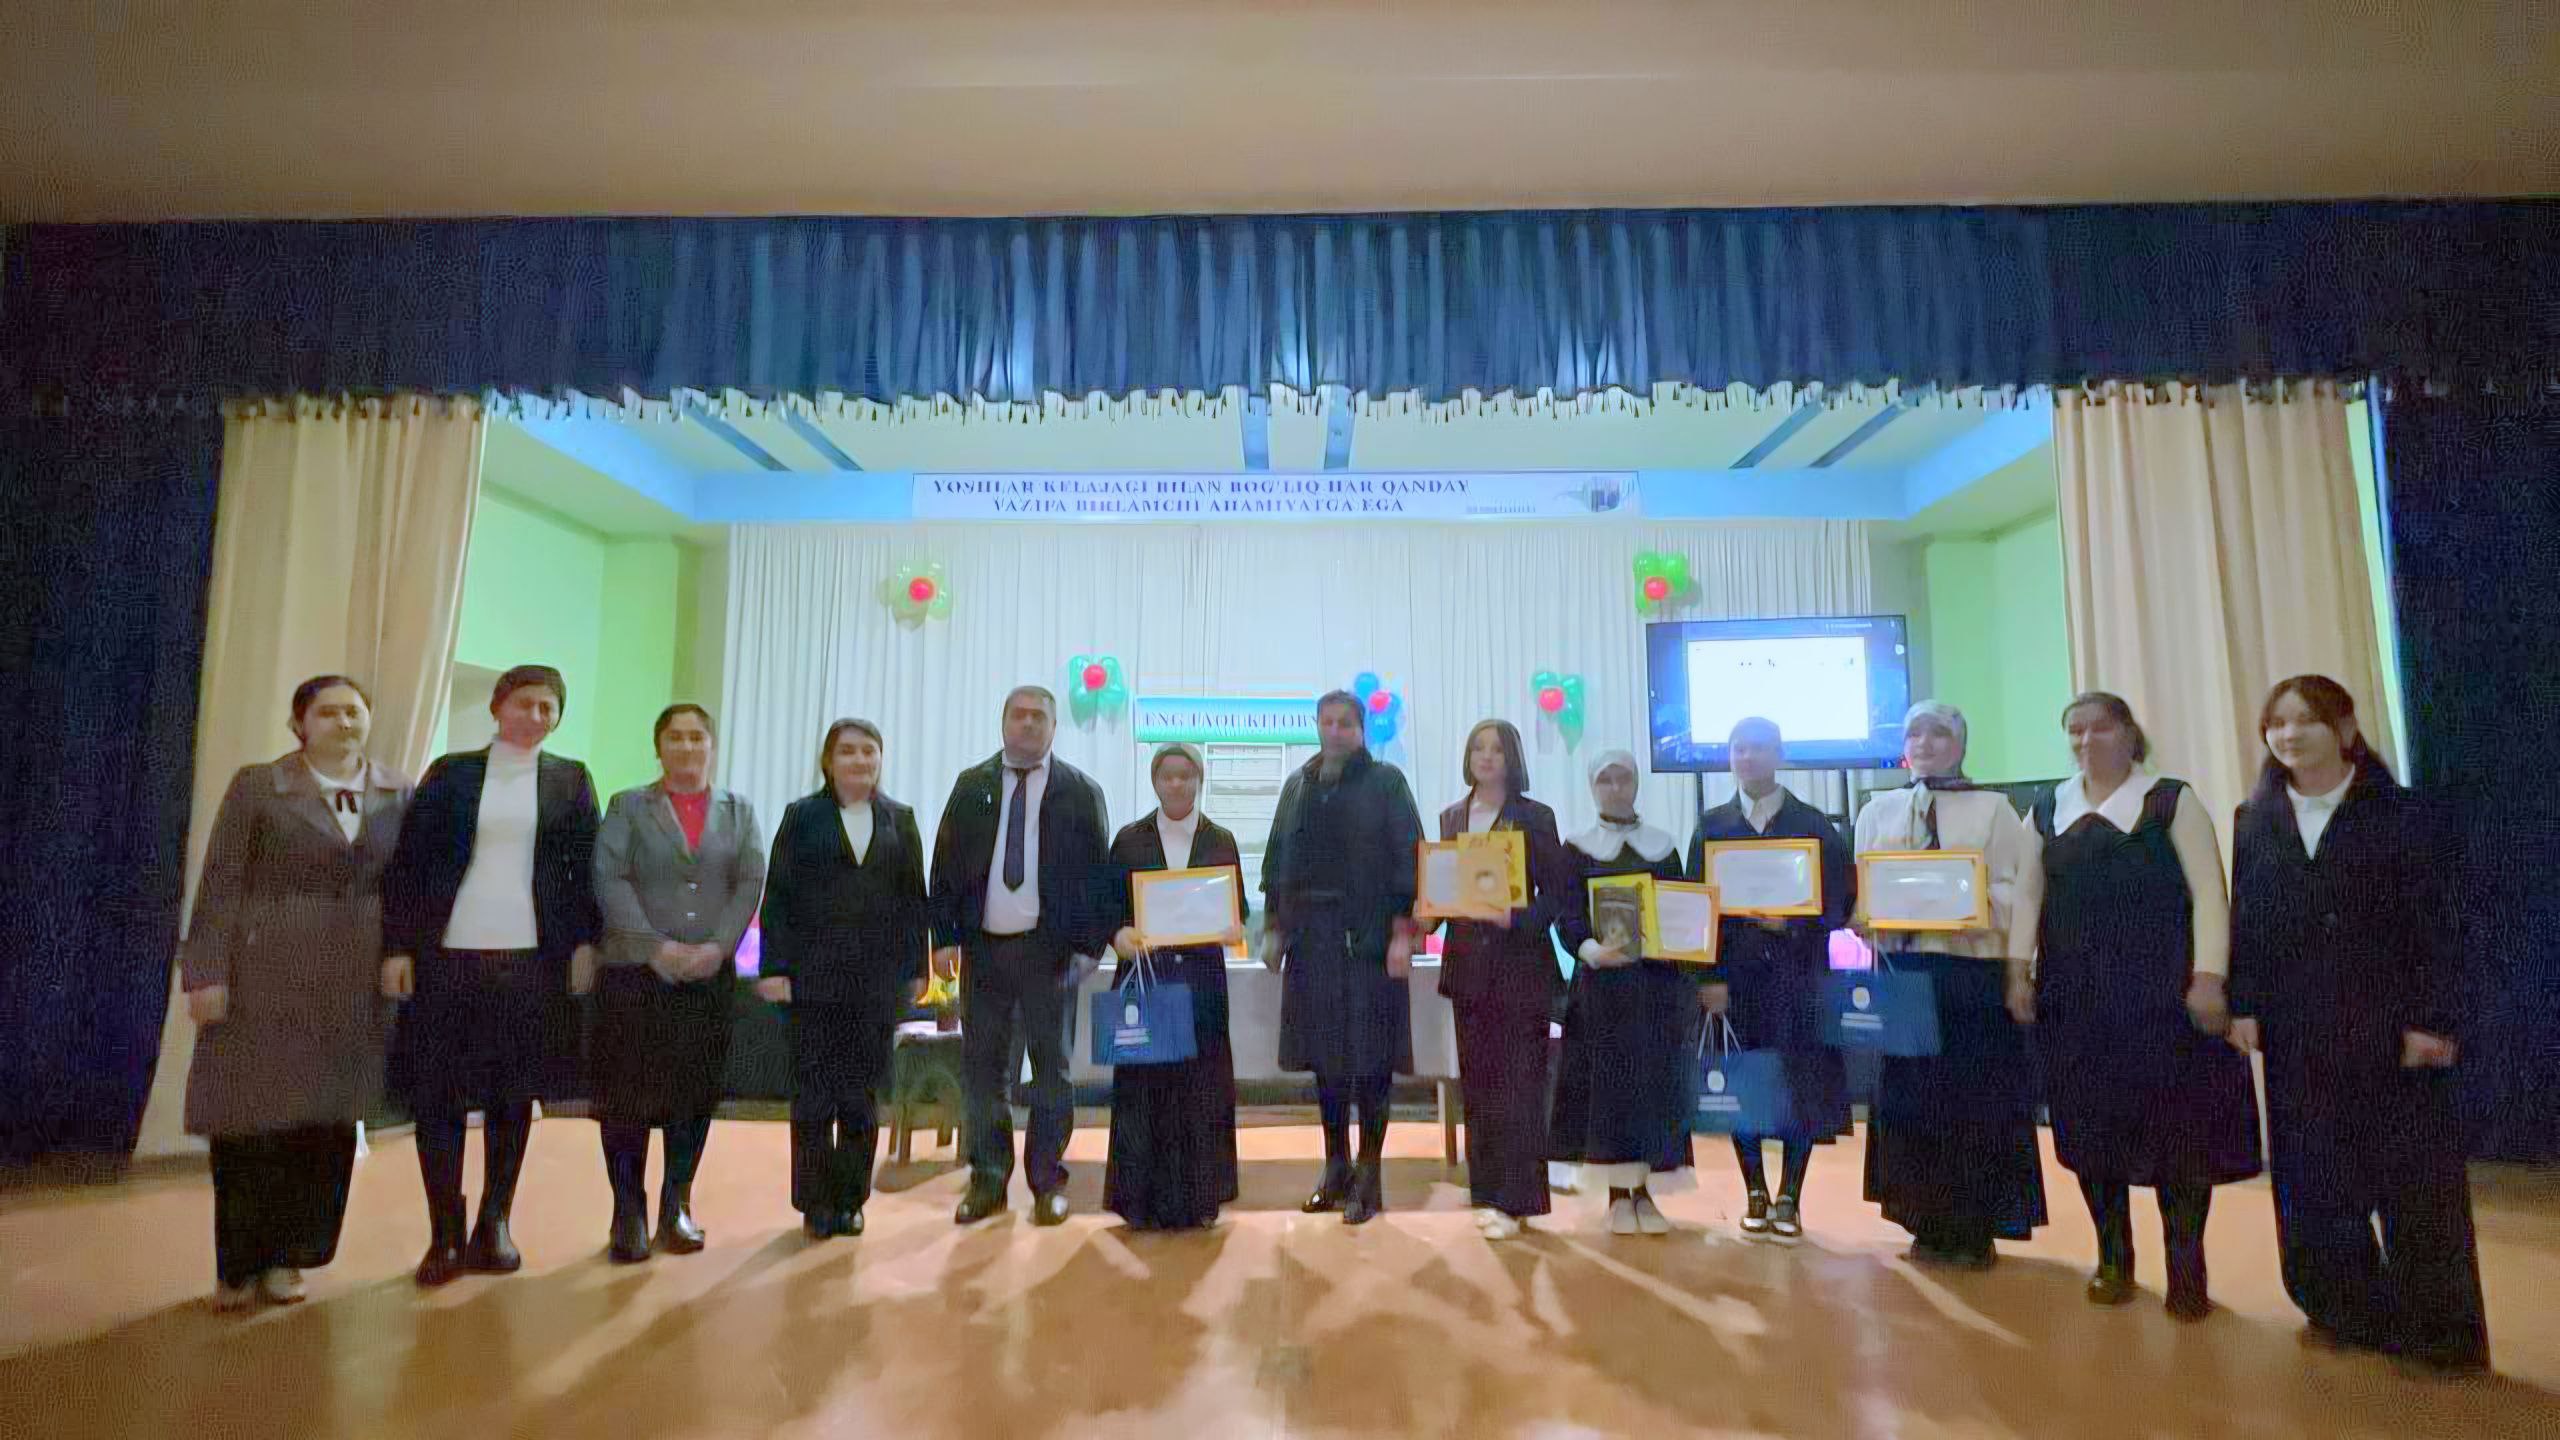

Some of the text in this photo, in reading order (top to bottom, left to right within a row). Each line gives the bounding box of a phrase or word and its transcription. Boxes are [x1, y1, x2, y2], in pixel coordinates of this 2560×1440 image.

[1329, 480, 1373, 493] HAR
[1382, 479, 1470, 494] QANDAY
[1362, 499, 1403, 512] EGA
